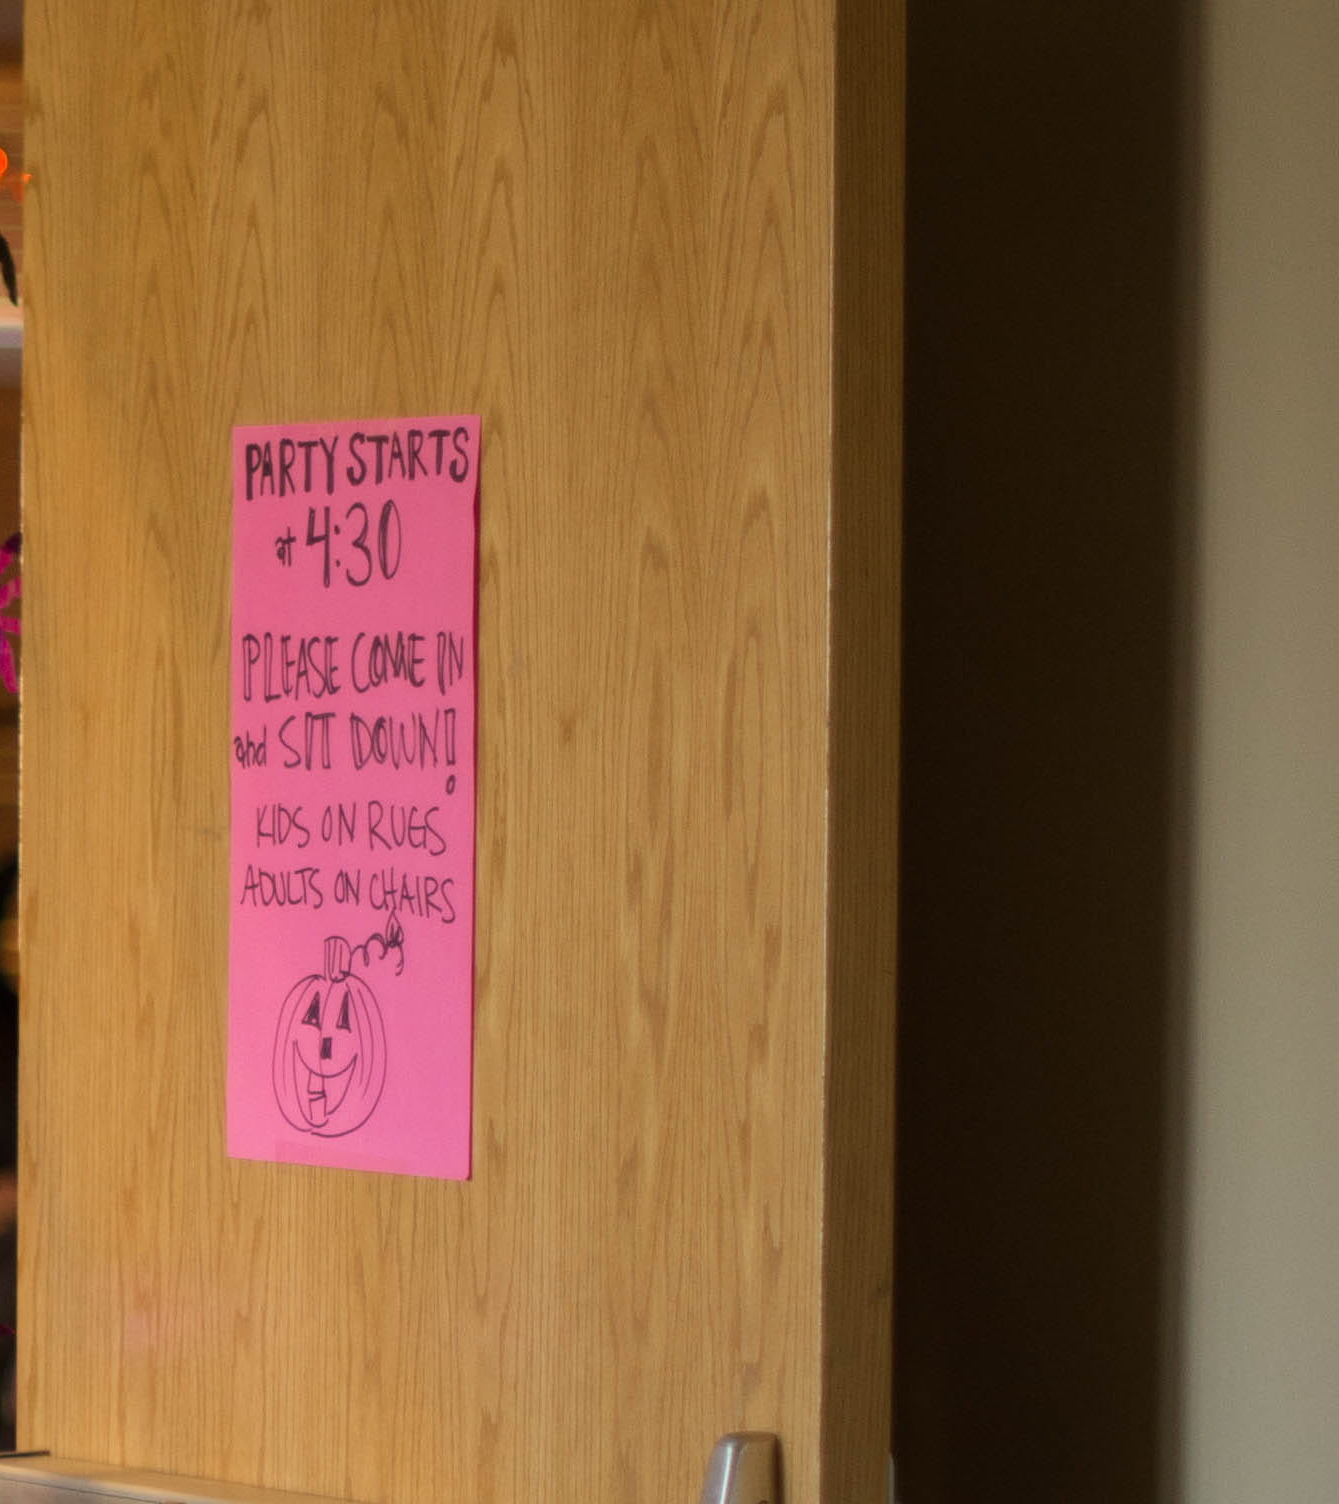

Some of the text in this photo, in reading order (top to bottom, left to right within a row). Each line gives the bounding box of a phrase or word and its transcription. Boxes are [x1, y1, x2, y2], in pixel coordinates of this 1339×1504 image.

[246, 427, 469, 501] PARTY STARTS
[275, 499, 401, 588] at 4:30
[243, 631, 464, 703] PLEASE COME IN
[234, 708, 456, 795] and SIT DOWN!
[257, 801, 447, 856] KIDS ON RUGS
[240, 864, 455, 924] ADULTS ON CHAIRS
